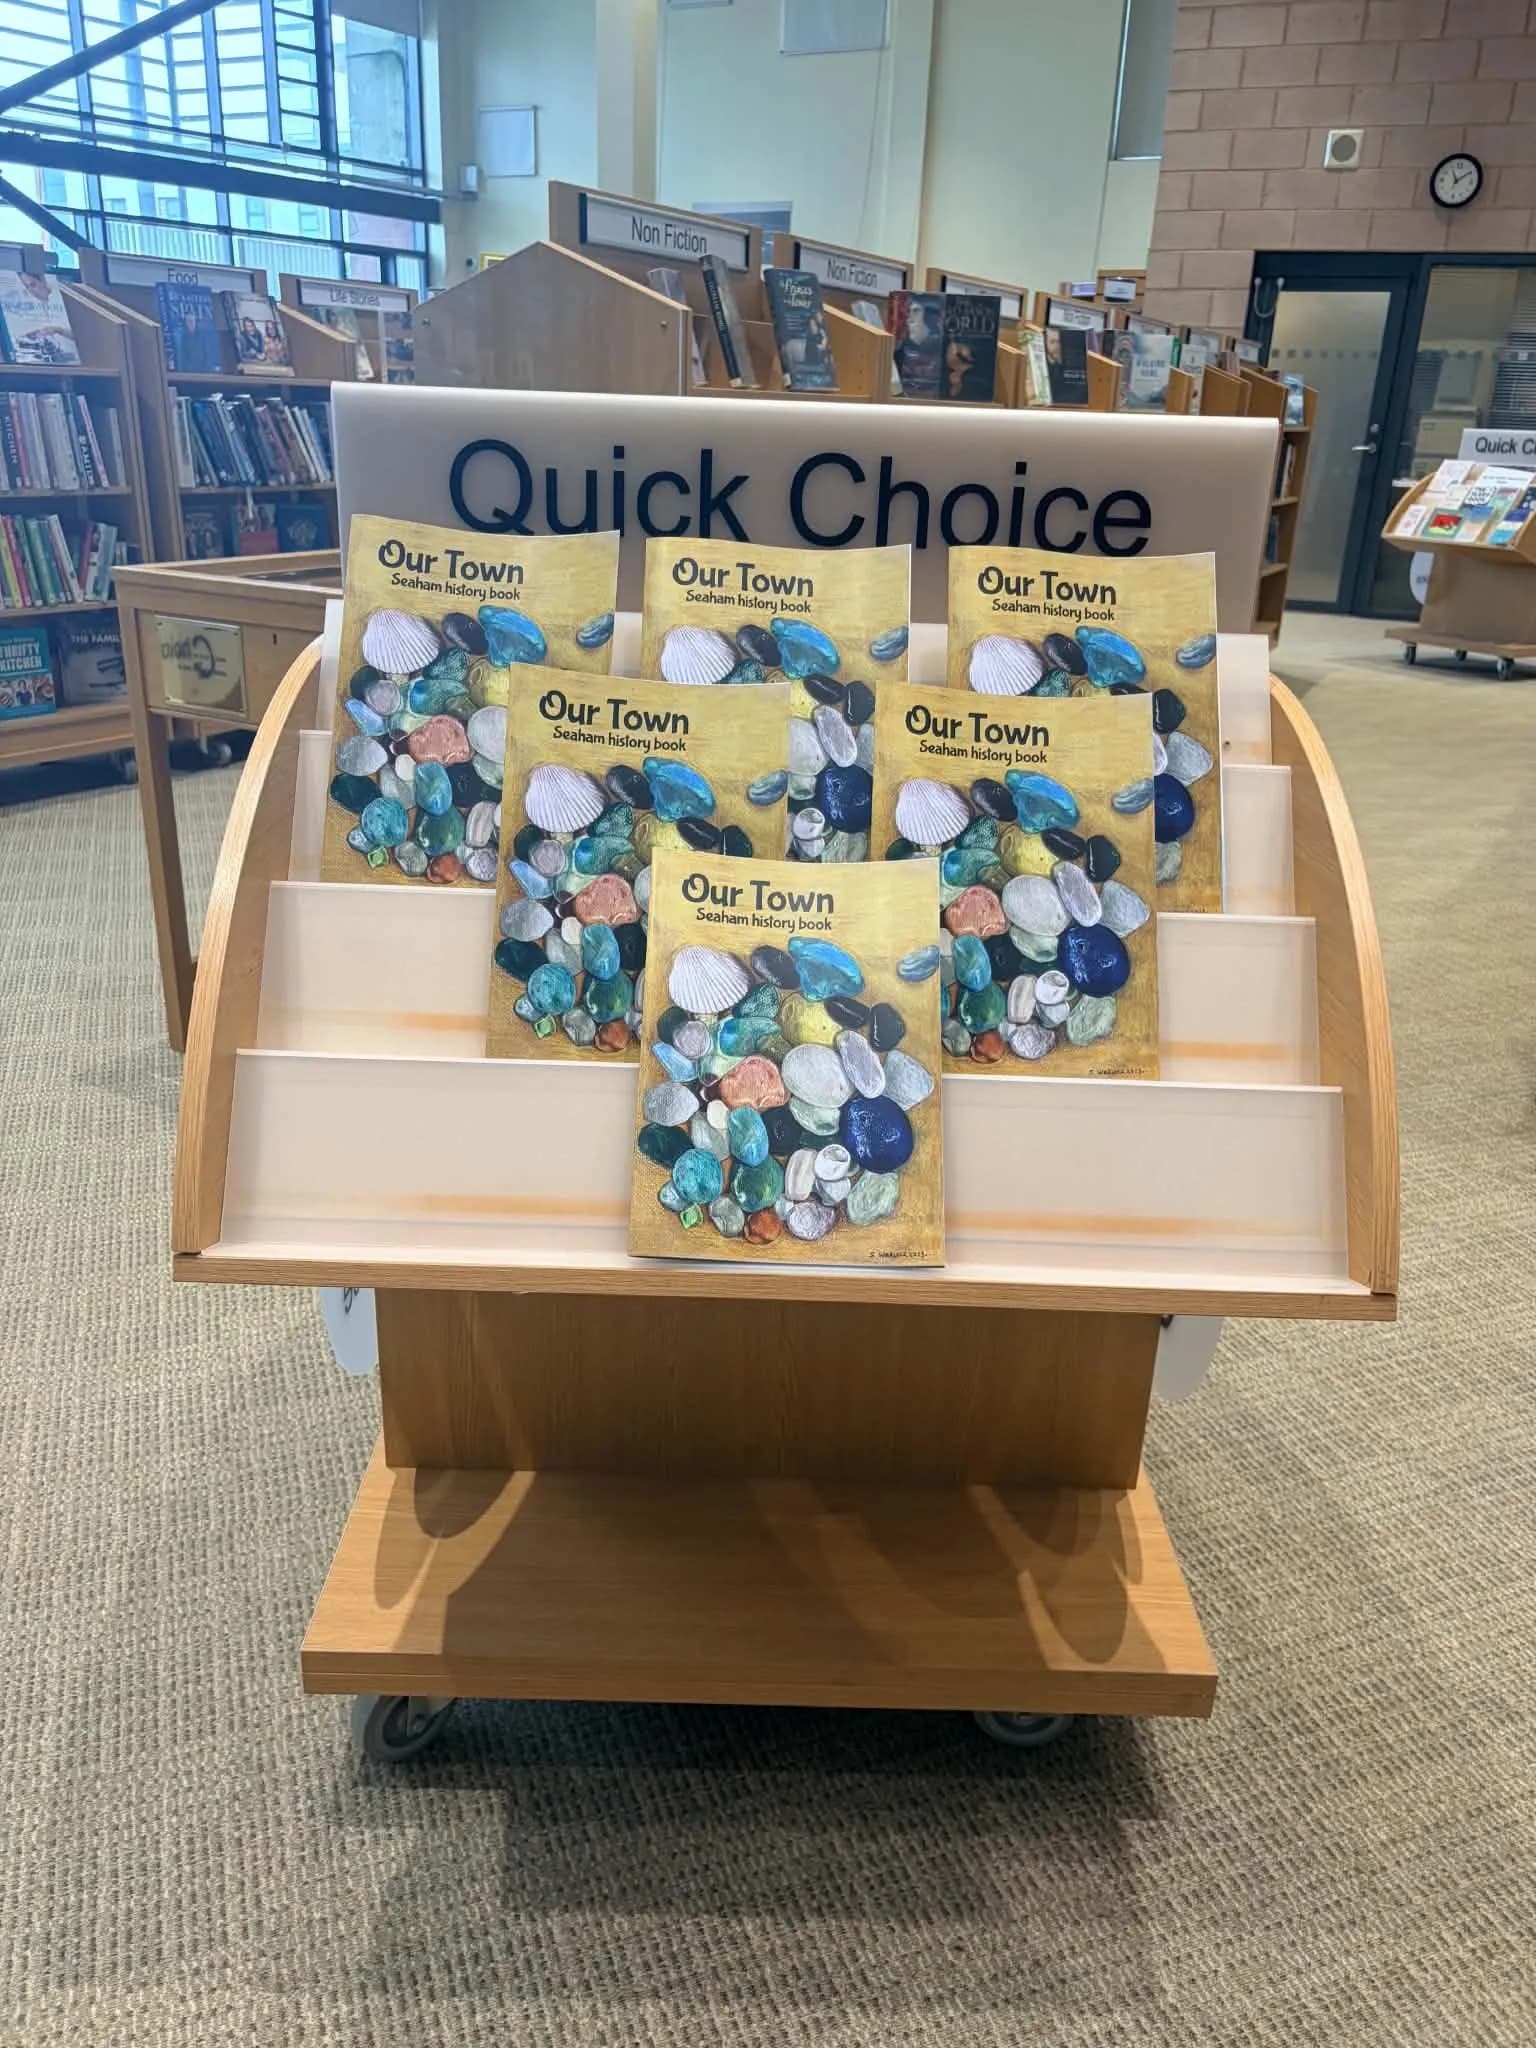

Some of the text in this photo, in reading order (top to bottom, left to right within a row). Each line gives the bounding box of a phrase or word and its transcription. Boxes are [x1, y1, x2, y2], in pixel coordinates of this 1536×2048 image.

[632, 215, 707, 254] Non Fiction
[167, 268, 199, 285] Food
[827, 258, 878, 289] Non Fiction
[1475, 436, 1517, 454] Quick
[449, 439, 1152, 557] Quick Choice
[378, 540, 523, 584] Our Town
[672, 557, 814, 597] Our Town
[391, 573, 520, 602] Seaham history book
[978, 566, 1116, 605] Our Town
[686, 590, 811, 614] Seaham history book
[992, 598, 1114, 623] Seaham history book
[539, 690, 689, 734] Our Town
[905, 704, 1049, 746] Our Town
[553, 726, 686, 753] Seaham history book
[920, 740, 1047, 766] Seaham history book
[681, 873, 834, 914] Our Town
[696, 907, 832, 933] Seaham history book
